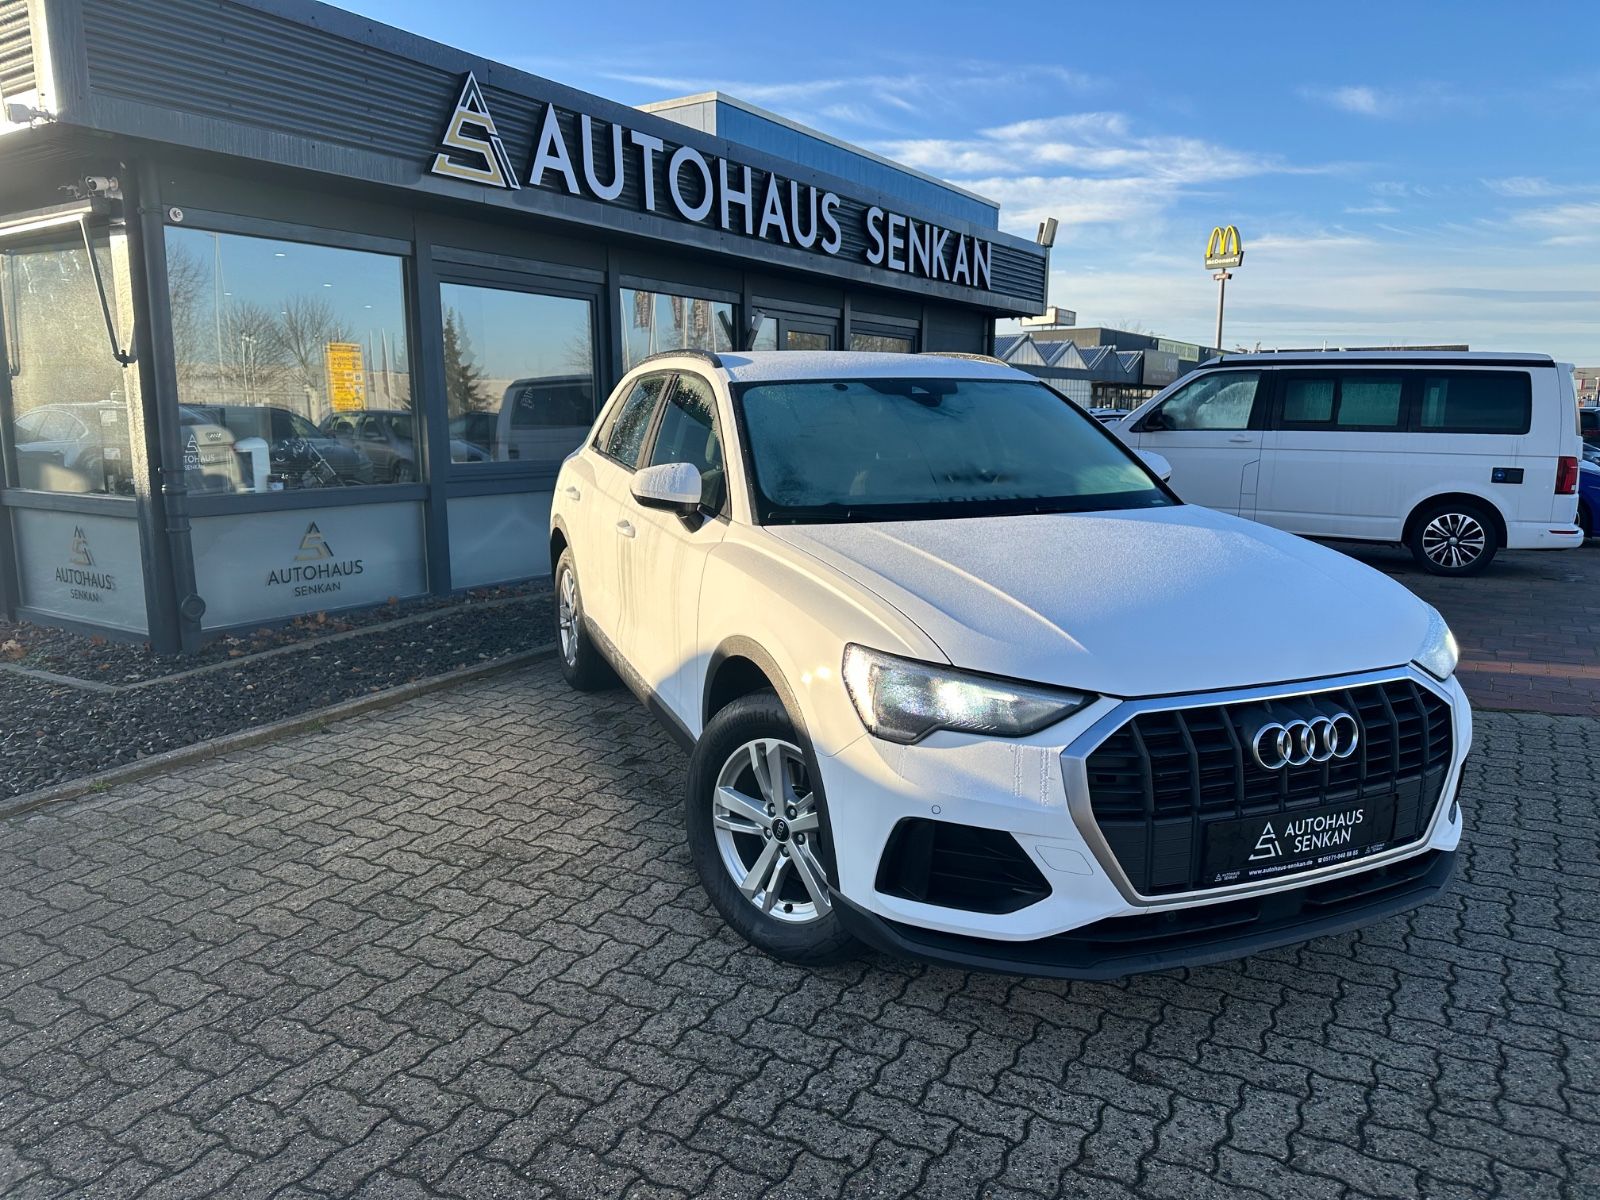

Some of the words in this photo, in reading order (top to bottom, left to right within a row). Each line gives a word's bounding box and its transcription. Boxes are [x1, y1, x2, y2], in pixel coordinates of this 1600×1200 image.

[529, 102, 841, 255] AUTOHAUS
[865, 206, 992, 291] SENKAN
[55, 566, 115, 591] AUTOHAUS
[267, 559, 364, 586] AUTOHAUS
[70, 588, 101, 603] SENKAN
[294, 581, 342, 598] SENKAN
[1284, 808, 1364, 838] AUTOHAUS
[1293, 827, 1352, 853] SENKAN
